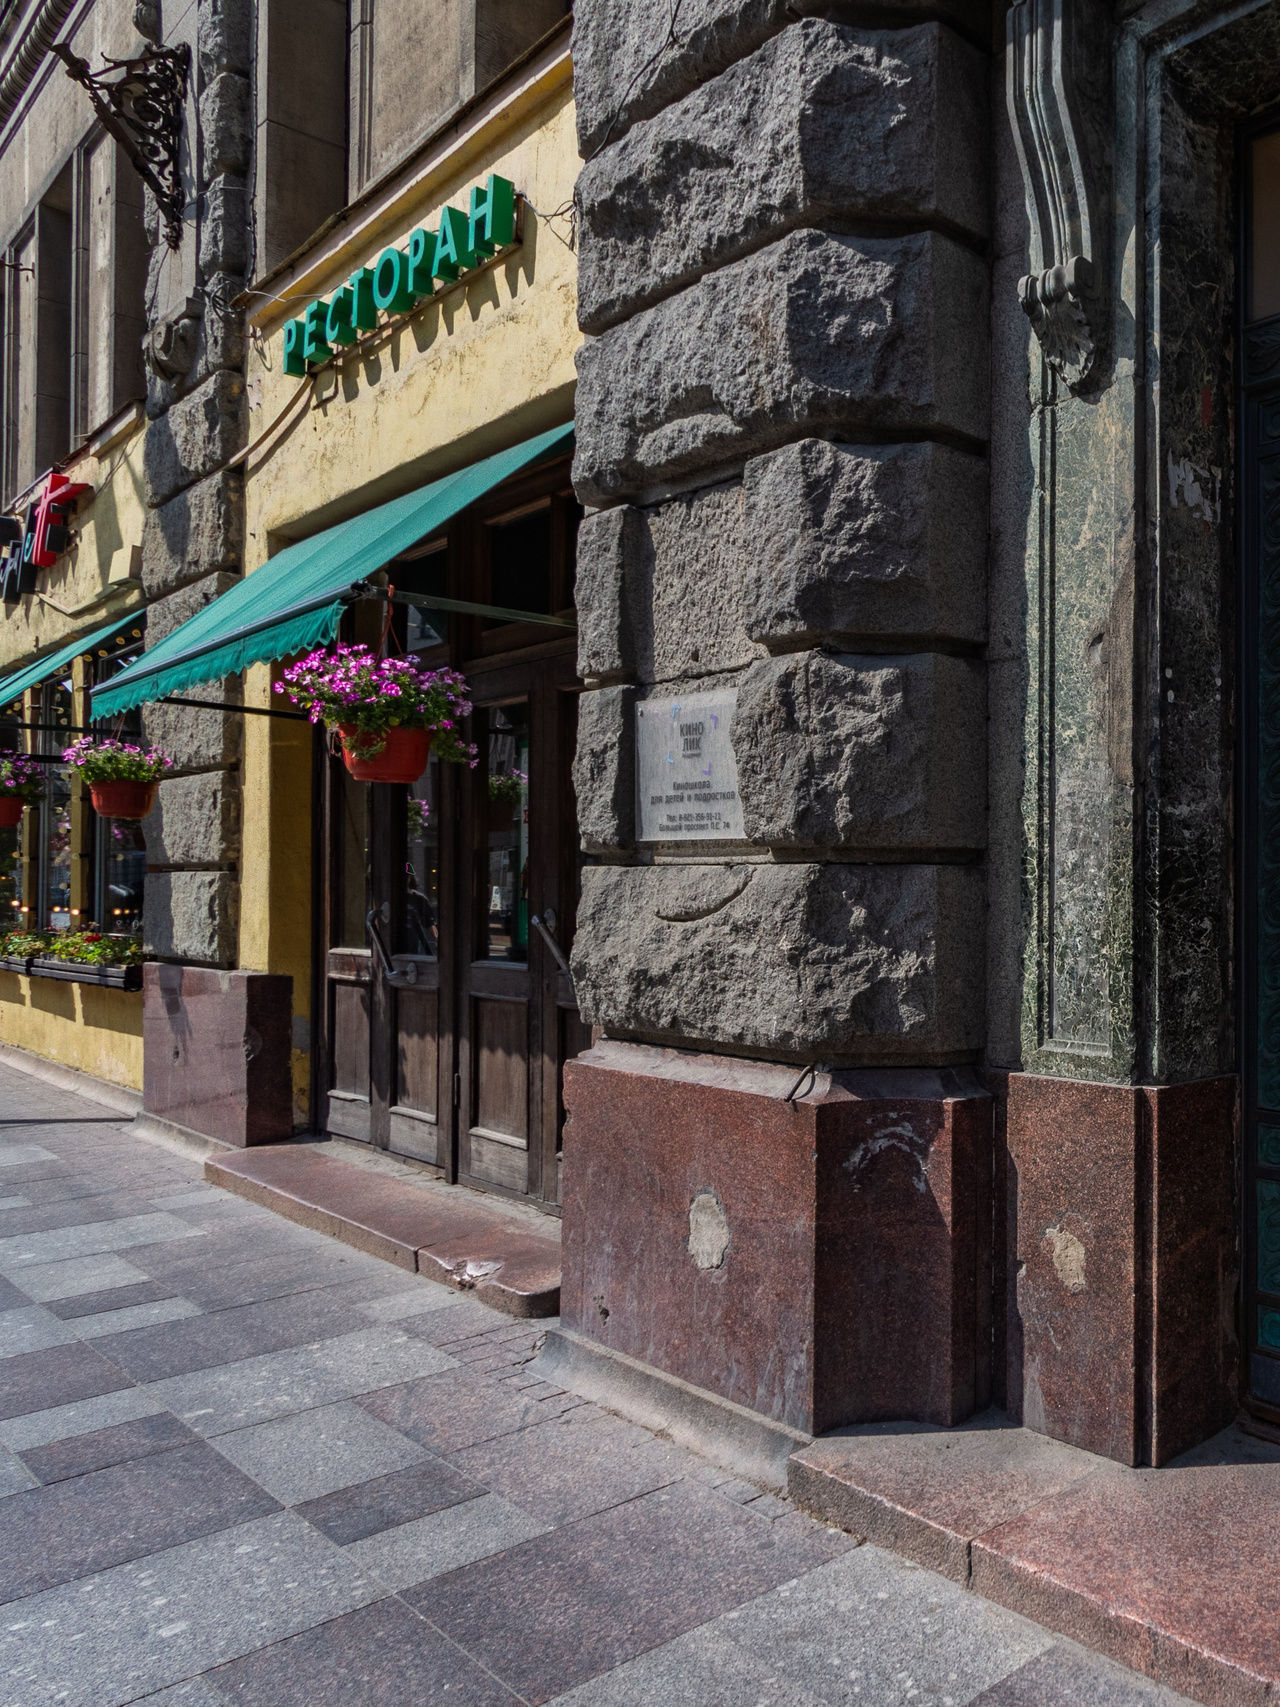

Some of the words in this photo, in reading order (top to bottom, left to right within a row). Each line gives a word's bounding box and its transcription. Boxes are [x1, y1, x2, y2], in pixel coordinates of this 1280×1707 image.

[283, 173, 512, 377] РЕСТОРАН
[679, 721, 704, 737] КИНО
[682, 737, 702, 752] ЛИК
[650, 795, 663, 805] для
[665, 792, 684, 804] детей
